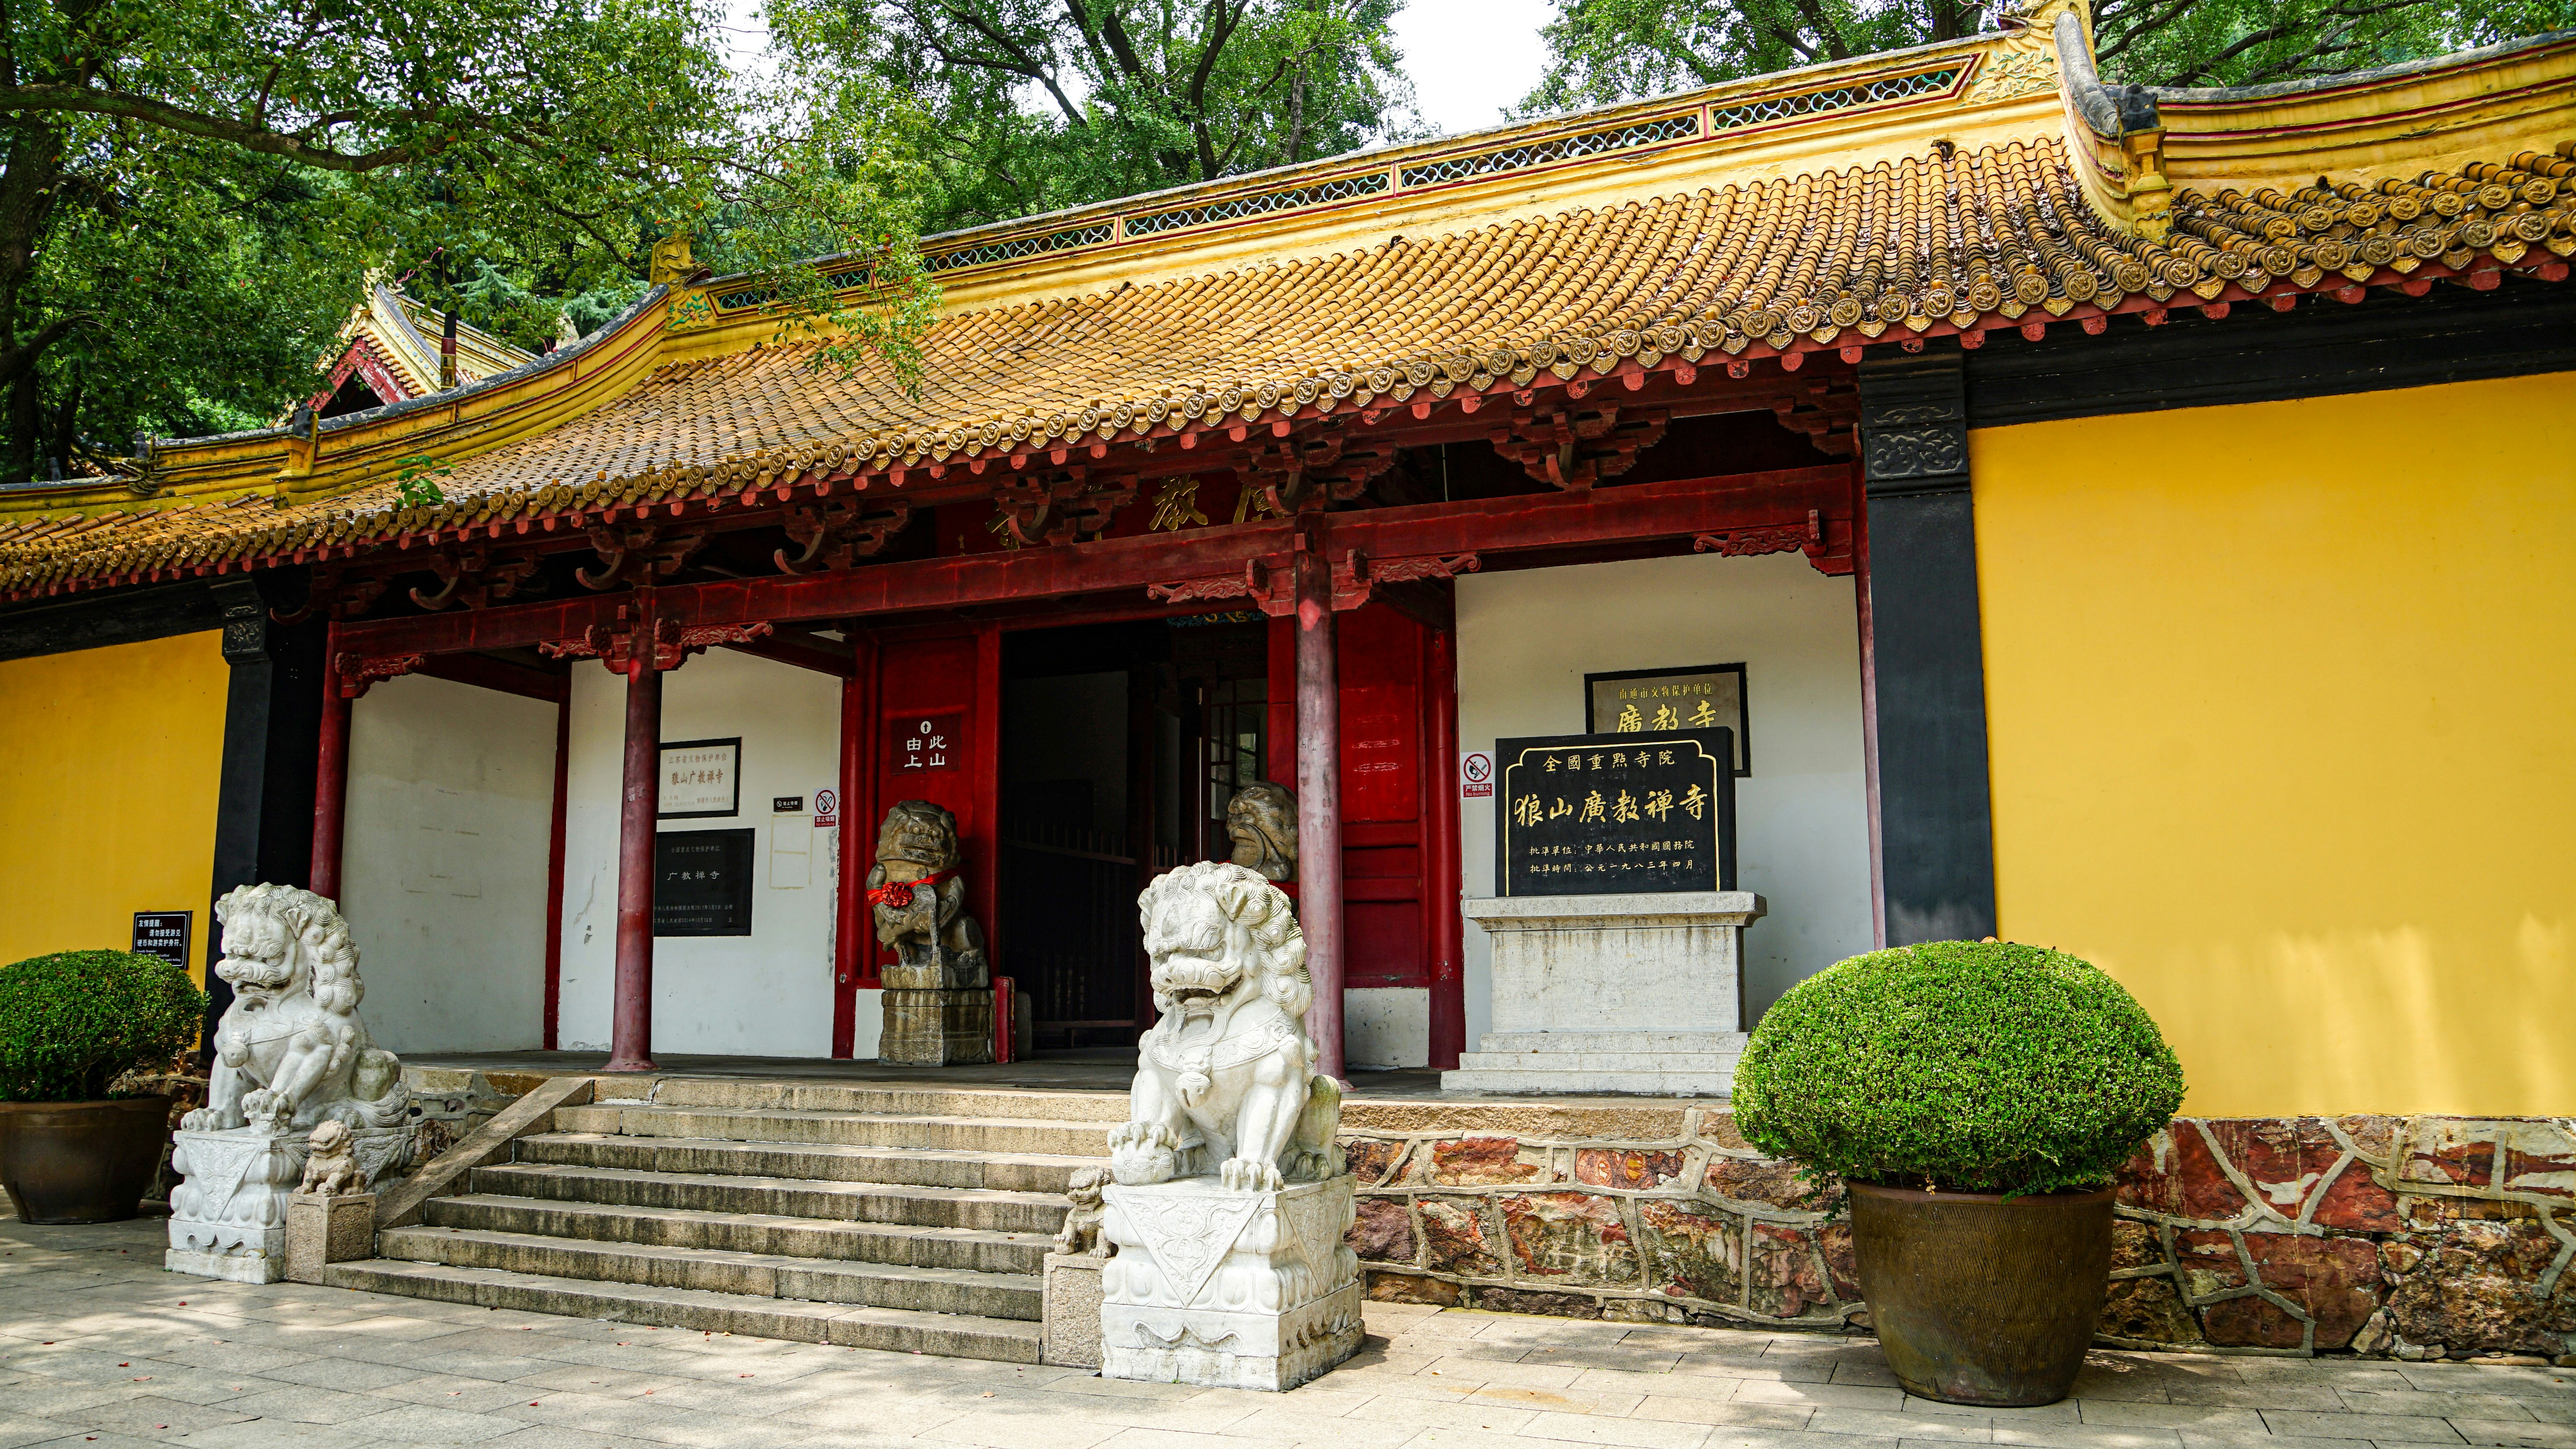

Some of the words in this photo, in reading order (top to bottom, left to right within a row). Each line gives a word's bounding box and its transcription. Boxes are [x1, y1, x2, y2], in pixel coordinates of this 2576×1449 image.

[1619, 683, 1713, 700] 南通市文物保护单位
[906, 735, 947, 752] 由此
[669, 753, 727, 764] 江苏省文物保护单位
[904, 753, 945, 768] 上山
[1543, 750, 1675, 772] 全國重點寺院
[671, 768, 723, 785] 狼山广教禅寺
[668, 871, 720, 880] 广教禅寺
